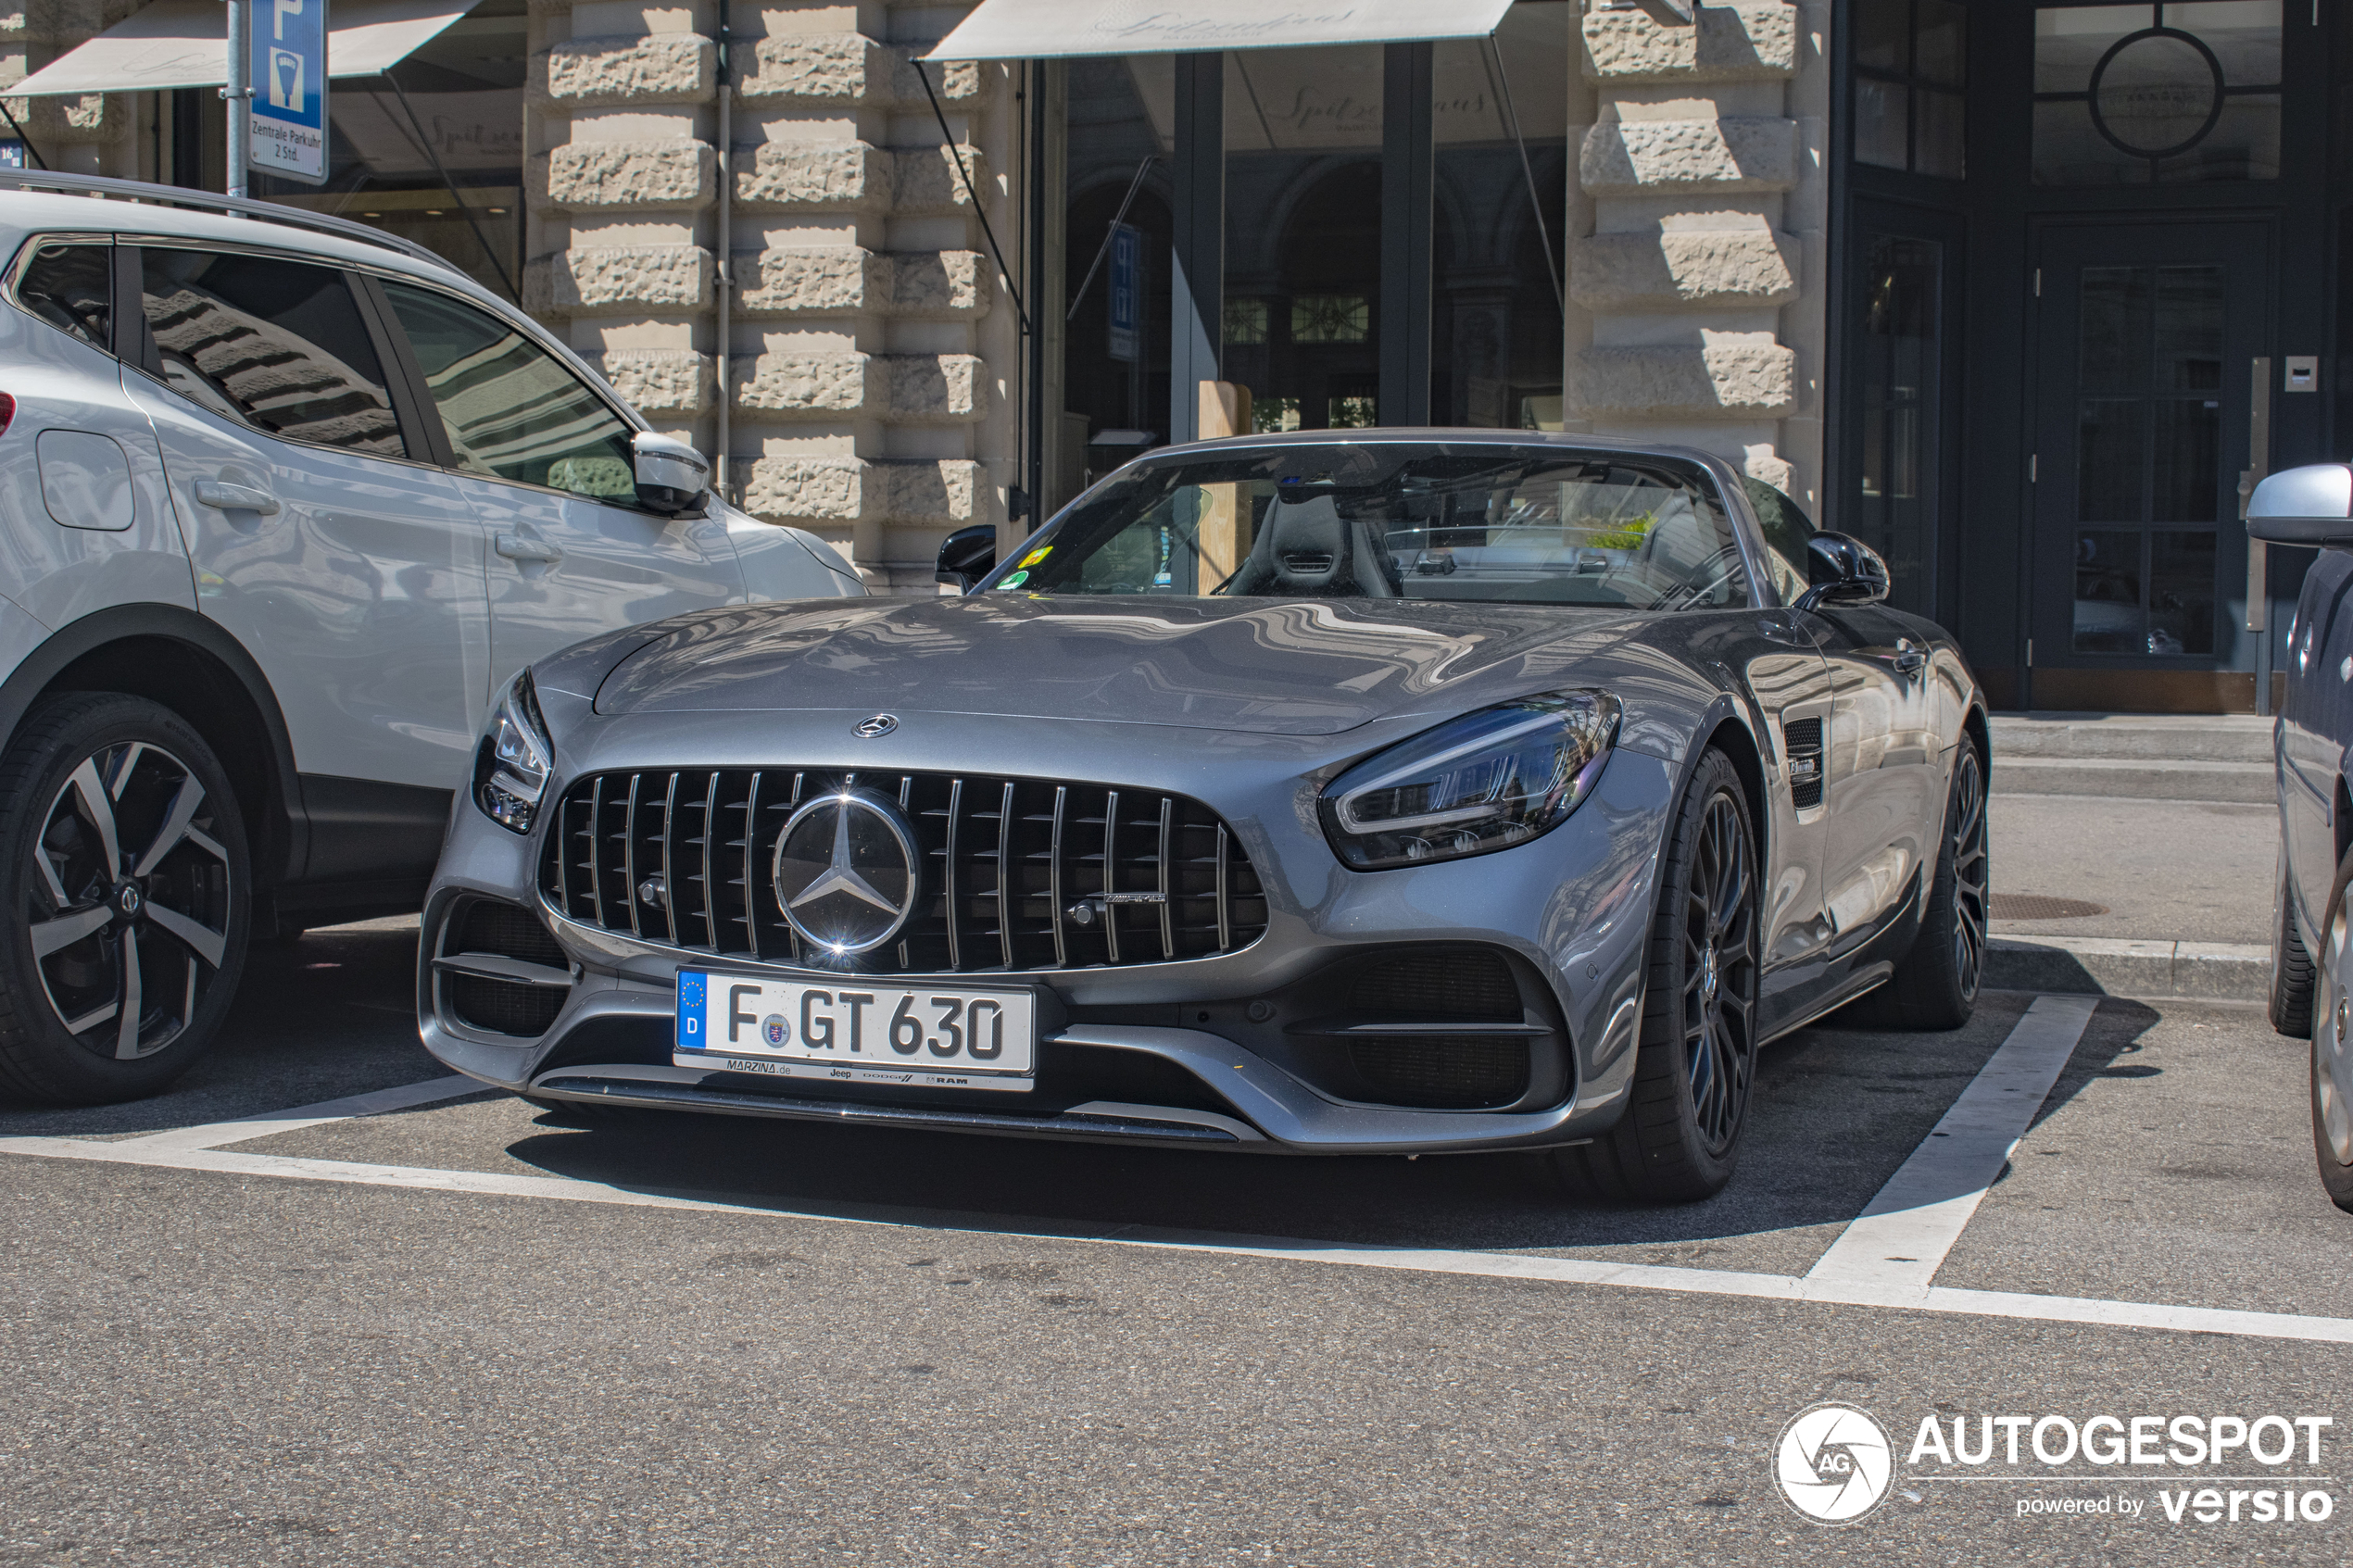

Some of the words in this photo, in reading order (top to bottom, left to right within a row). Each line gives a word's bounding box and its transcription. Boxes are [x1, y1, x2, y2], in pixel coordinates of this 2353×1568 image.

[252, 120, 287, 141] Zentrale
[290, 130, 321, 149] Parkuhr
[275, 144, 281, 157] 2
[283, 145, 300, 161] Std.
[686, 1017, 698, 1034] D
[728, 984, 762, 1042] F
[800, 988, 875, 1052] GT
[887, 995, 1003, 1060] 630
[726, 1060, 791, 1074] MARZINA.de
[830, 1069, 852, 1080] Jeep
